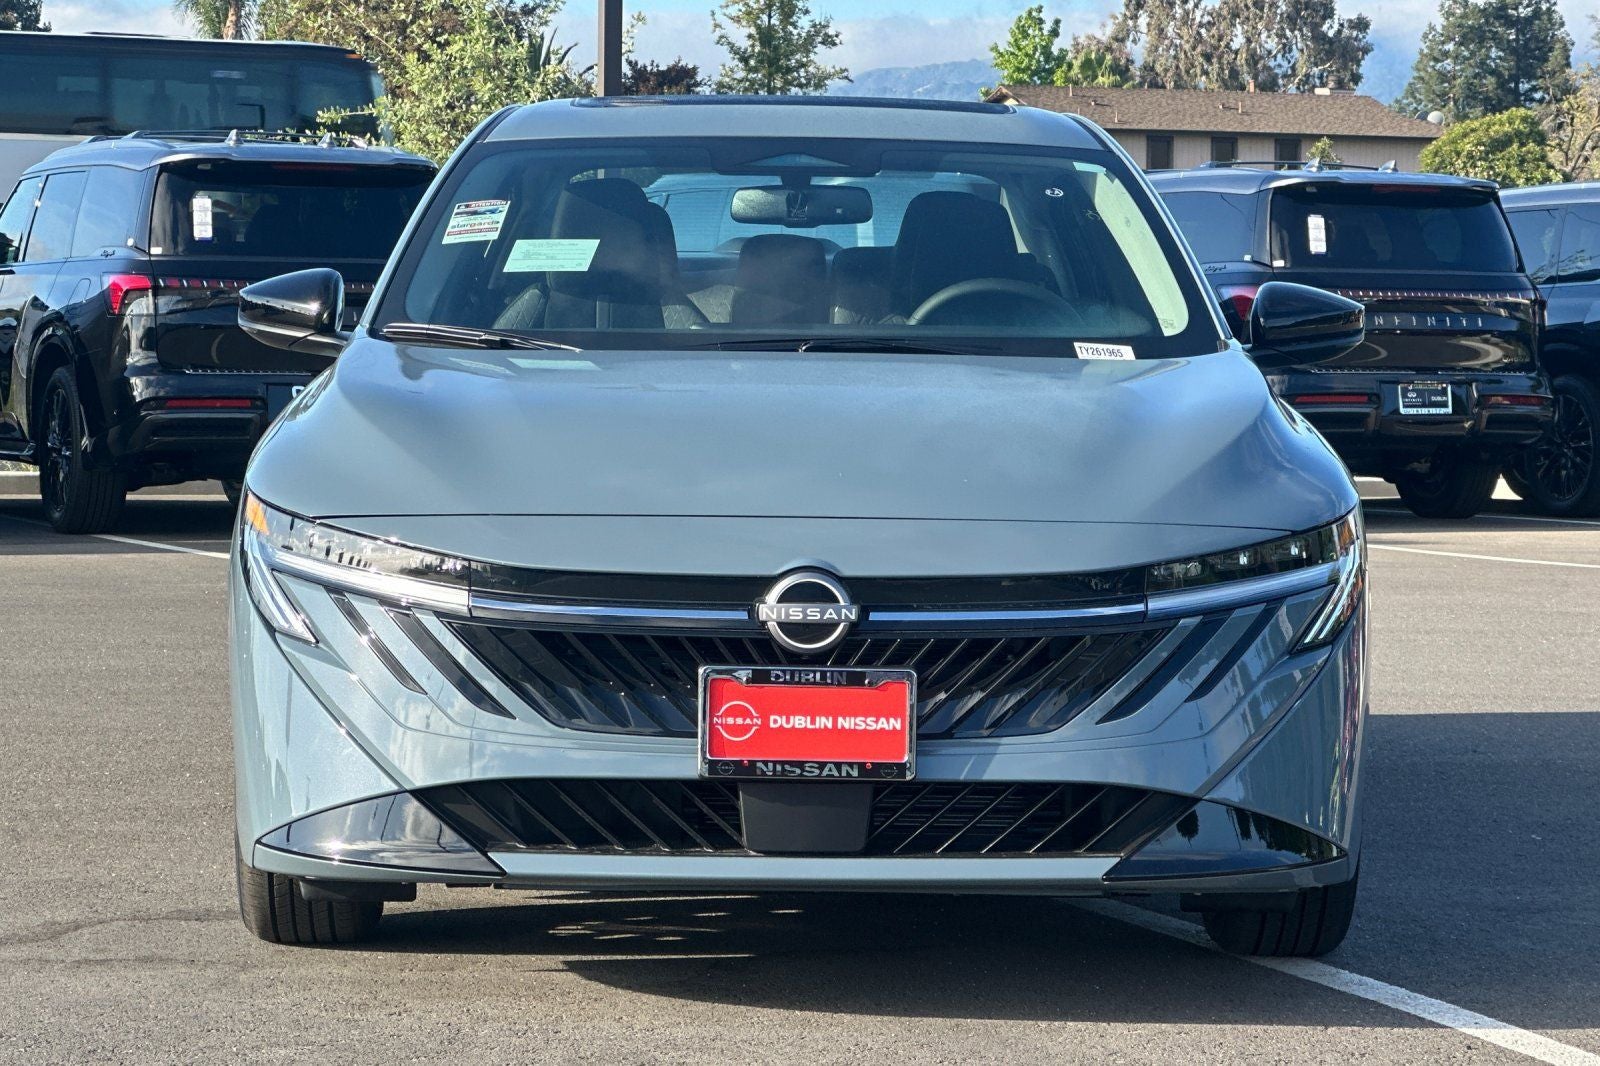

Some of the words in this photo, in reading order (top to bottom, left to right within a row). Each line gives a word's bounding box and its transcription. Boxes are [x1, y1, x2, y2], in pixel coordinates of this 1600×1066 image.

[1077, 345, 1124, 358] TY261965
[762, 607, 856, 620] NISSAN
[770, 670, 847, 685] DUBLIN
[713, 716, 762, 726] NISSAN
[769, 715, 833, 730] DUBLIN
[837, 717, 902, 731] NISSAN
[756, 762, 859, 778] NISSAN
